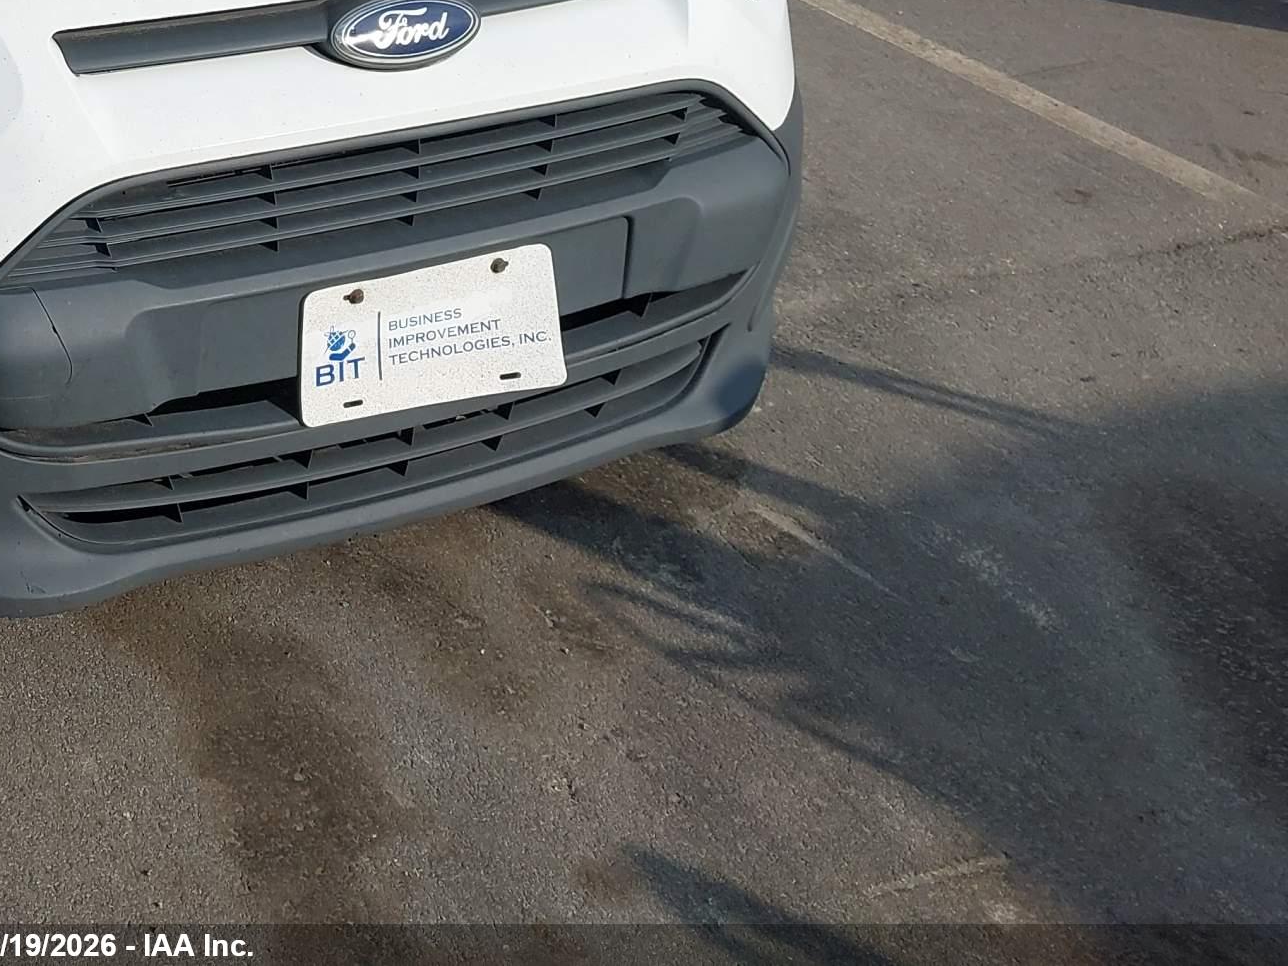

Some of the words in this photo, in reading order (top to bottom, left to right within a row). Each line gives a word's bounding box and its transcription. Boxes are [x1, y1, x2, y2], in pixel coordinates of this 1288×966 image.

[372, 6, 450, 50] Ford
[388, 307, 463, 332] BUSINESS
[388, 319, 502, 349] IMPROVEMENT
[388, 335, 516, 366] TECHNOLOGIES,
[518, 330, 552, 345] INC.
[315, 356, 366, 387] BIT
